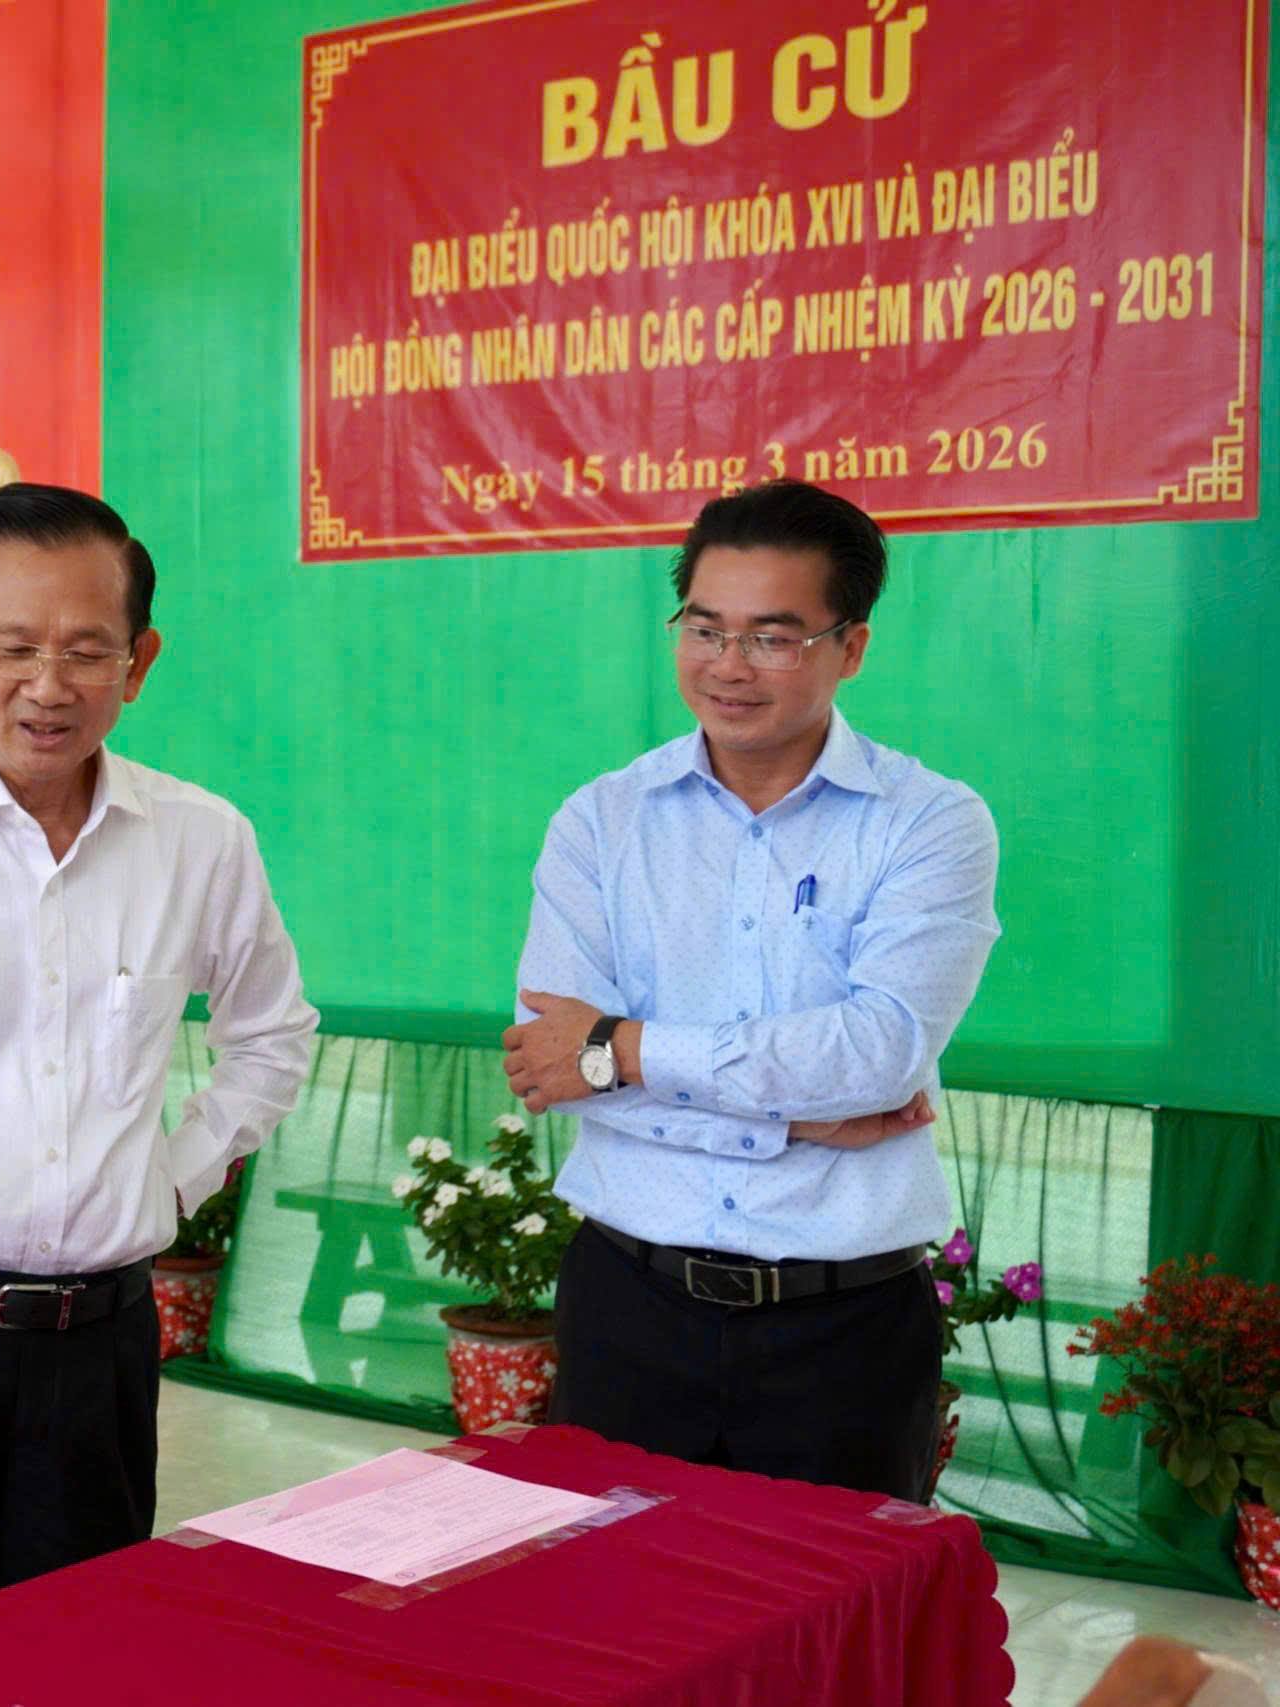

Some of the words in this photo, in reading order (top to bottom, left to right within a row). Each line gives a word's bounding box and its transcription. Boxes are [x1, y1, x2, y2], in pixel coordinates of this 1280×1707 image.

[541, 32, 734, 168] BẦU
[772, 0, 928, 131] CỬ
[410, 237, 460, 308] ĐẠI
[468, 206, 538, 290] BIỂU
[546, 196, 630, 287] QUỐC
[639, 195, 694, 280] HỘI
[704, 182, 795, 261] KHÓA
[806, 182, 863, 249] XVI
[874, 161, 920, 240] VÀ
[932, 163, 996, 244] ĐẠI
[1007, 127, 1099, 226] BIỂU
[330, 332, 376, 410] HỘI
[384, 318, 462, 396] ĐỒNG
[471, 314, 556, 388] NHÂN
[564, 305, 630, 378] DÂN
[639, 296, 704, 372] CÁC
[715, 279, 784, 363] CẤP
[793, 274, 911, 363] NHIỆM
[922, 264, 971, 344] KỲ
[981, 265, 1076, 338] 2026
[1089, 290, 1104, 308] -
[1116, 251, 1214, 325] 2031
[441, 461, 542, 515] Ngày
[560, 454, 606, 498] 15
[619, 447, 748, 499] tháng
[761, 441, 787, 484] 3
[803, 436, 910, 482] năm
[926, 421, 1048, 476] 2026
